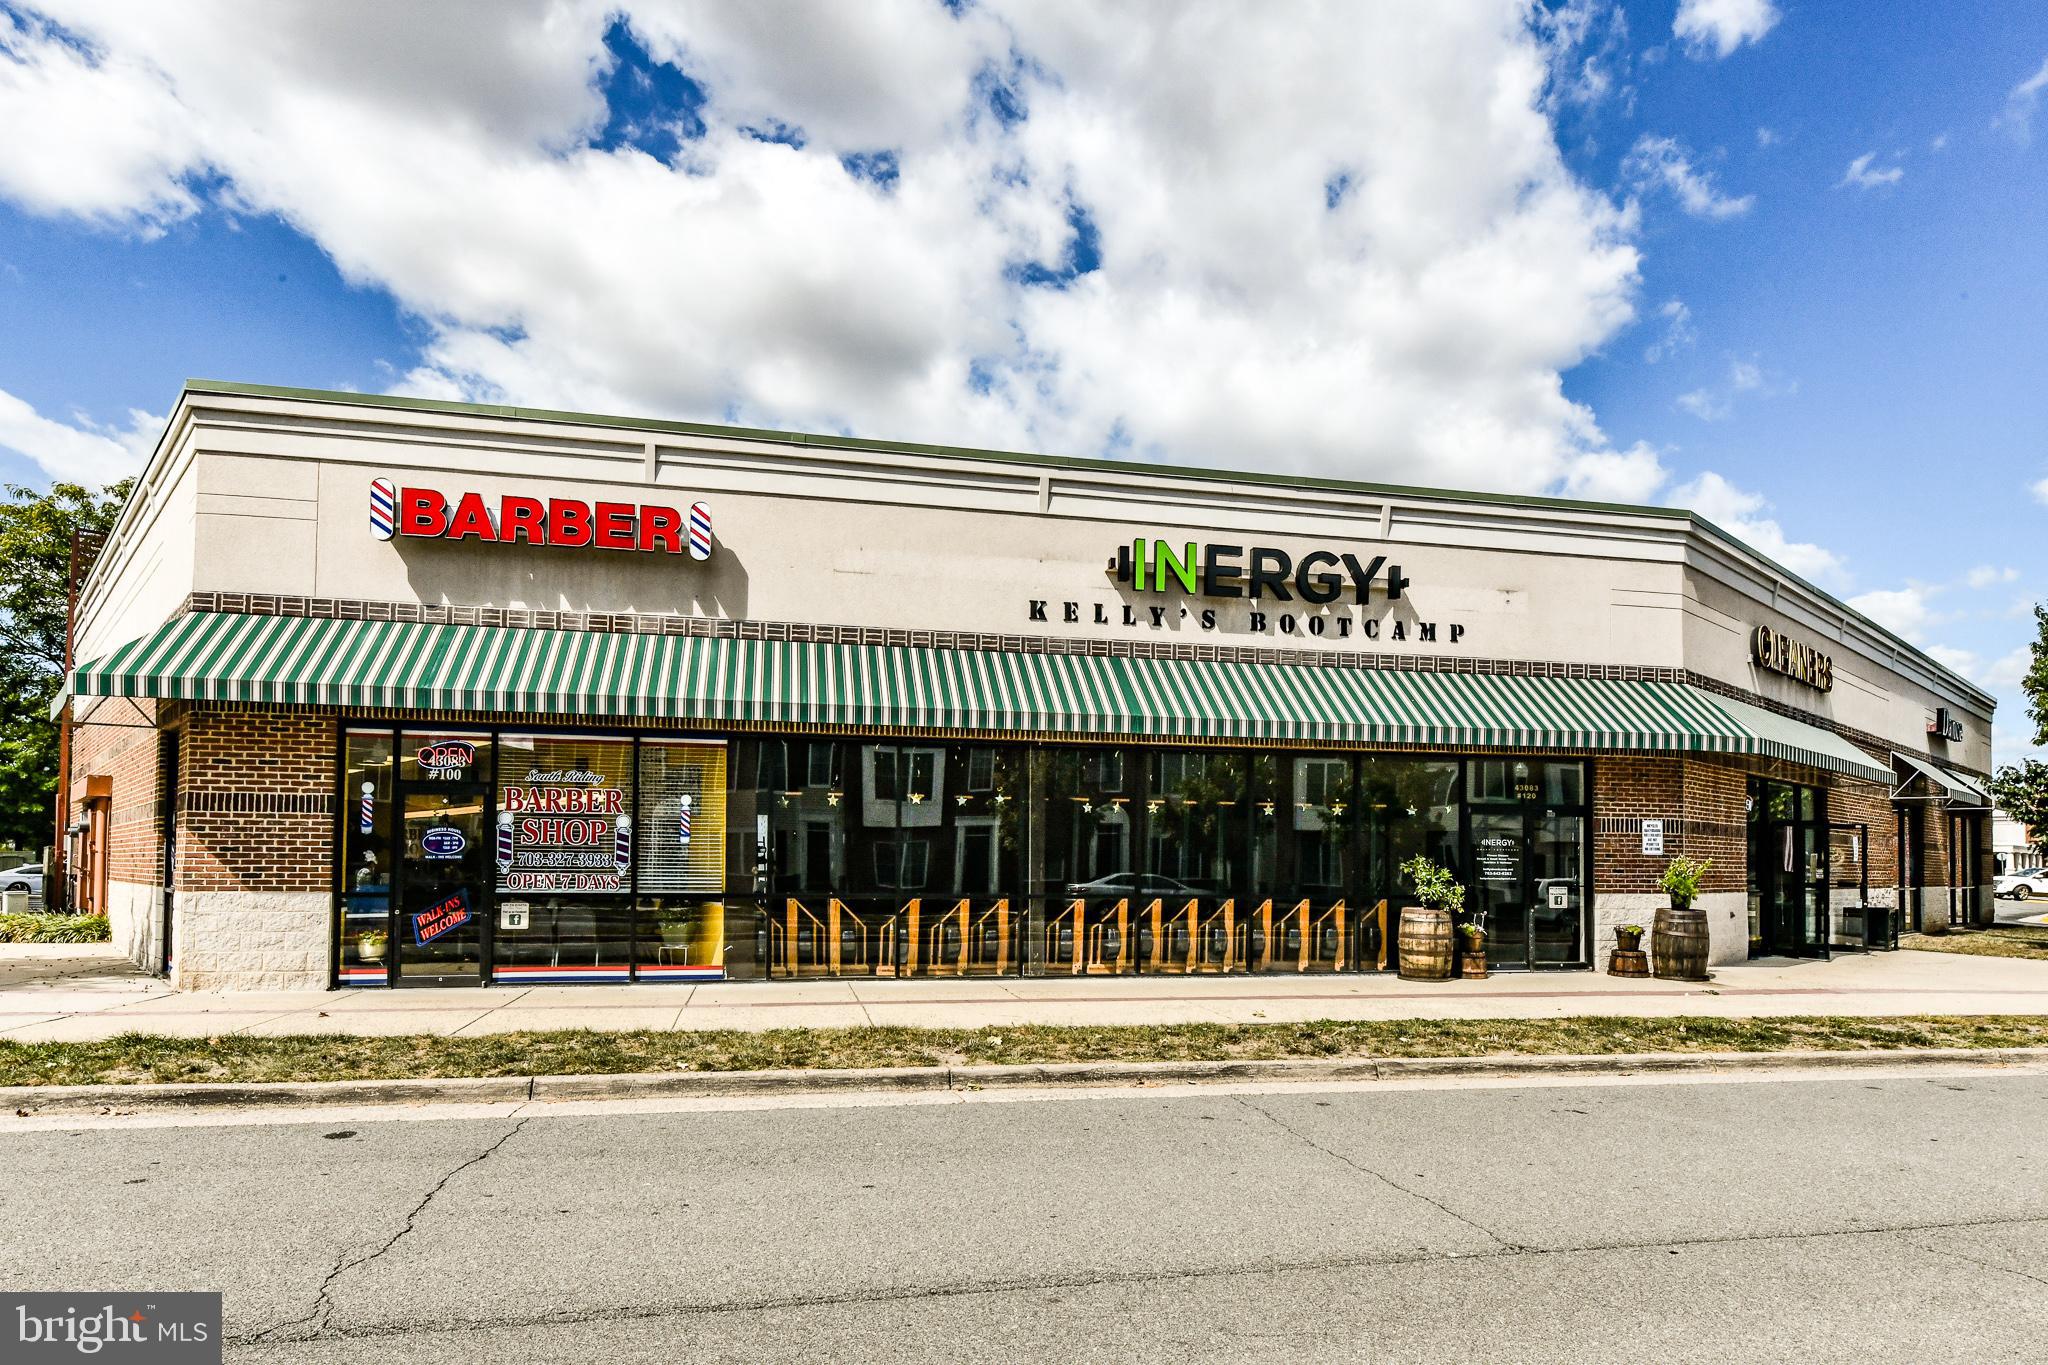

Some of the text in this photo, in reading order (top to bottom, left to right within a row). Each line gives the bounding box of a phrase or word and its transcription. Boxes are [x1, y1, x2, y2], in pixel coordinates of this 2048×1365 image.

[400, 486, 682, 554] BARBER
[1133, 537, 1388, 606] INERGY
[1029, 600, 1466, 644] KELLY'S BOOTCAMP
[1751, 625, 1833, 693] CLEANERS
[417, 746, 472, 764] OPEN
[428, 768, 462, 780] #100
[525, 769, 605, 786] South Riding
[503, 787, 625, 814] BARBER
[520, 818, 608, 845] SHOP
[517, 851, 612, 867] 703-327-3933
[506, 872, 620, 891] OPEN 7 DAYS
[416, 896, 461, 927] WALK-INS
[420, 907, 467, 940] WELCOME
